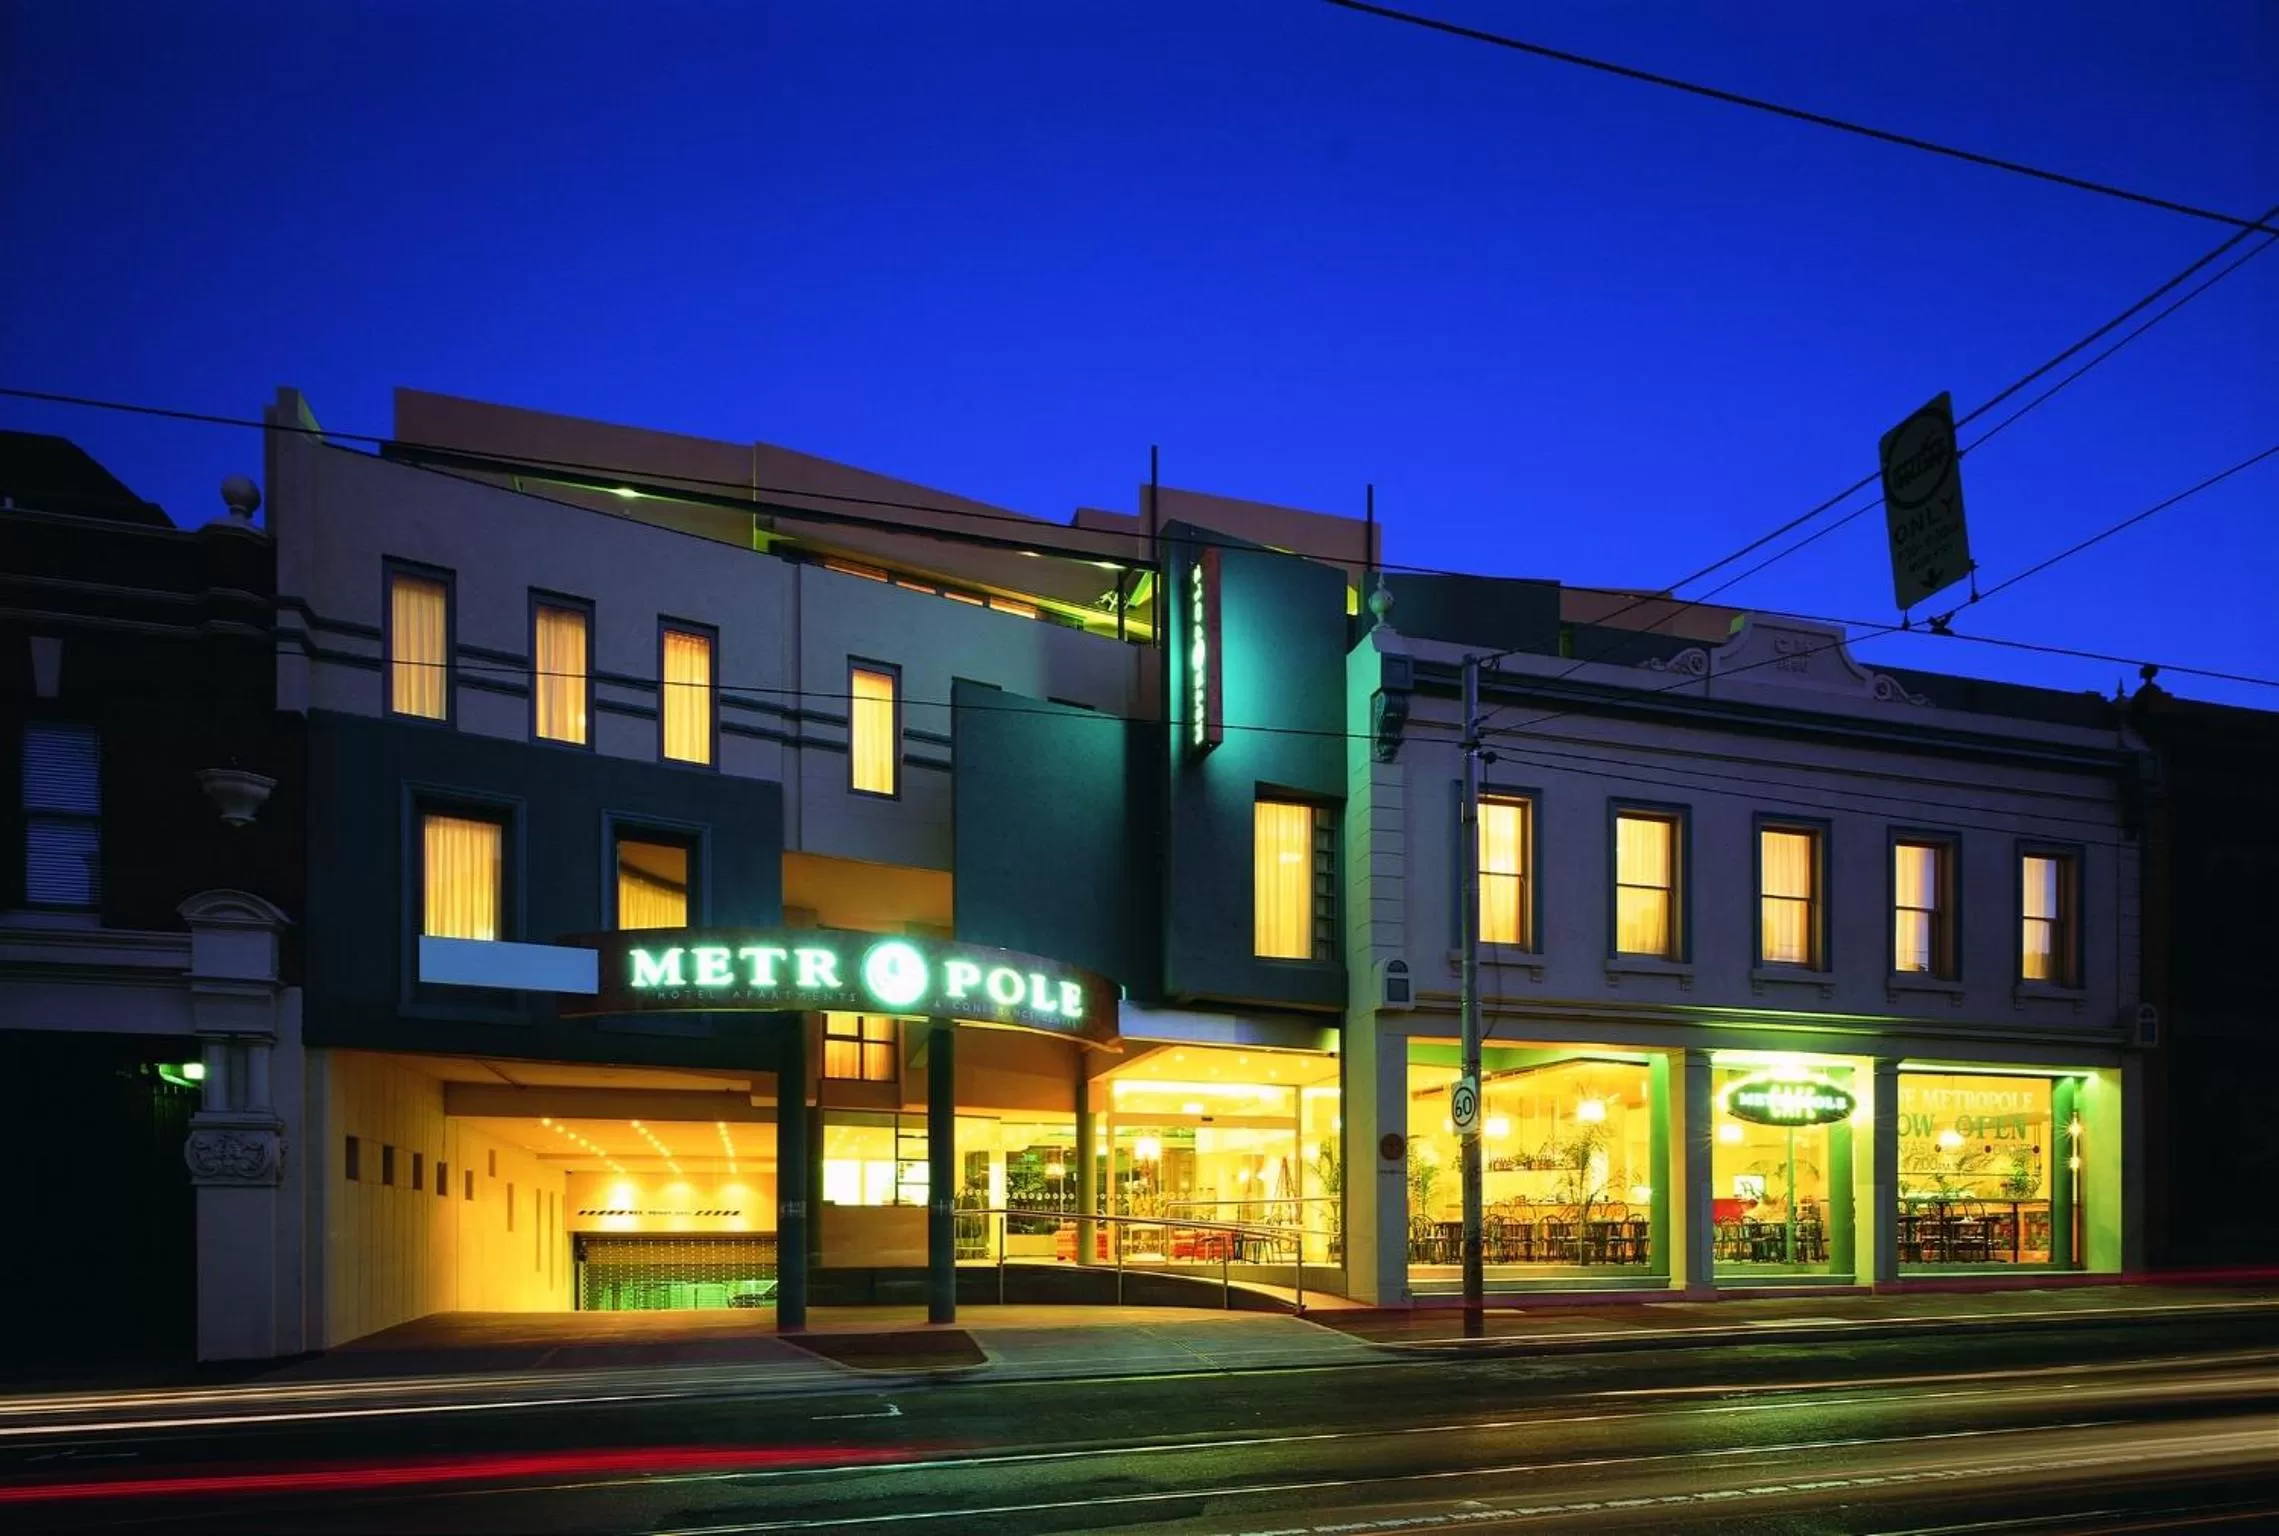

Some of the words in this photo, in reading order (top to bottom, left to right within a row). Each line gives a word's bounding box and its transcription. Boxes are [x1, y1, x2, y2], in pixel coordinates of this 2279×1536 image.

[1893, 496, 1954, 545] ONLY
[658, 990, 714, 1000] HOTEL
[732, 990, 856, 1002] APARTMENTS
[1456, 1096, 1473, 1117] 60
[1922, 1088, 2033, 1112] METROPOLE
[1955, 1114, 2027, 1140] OPEN
